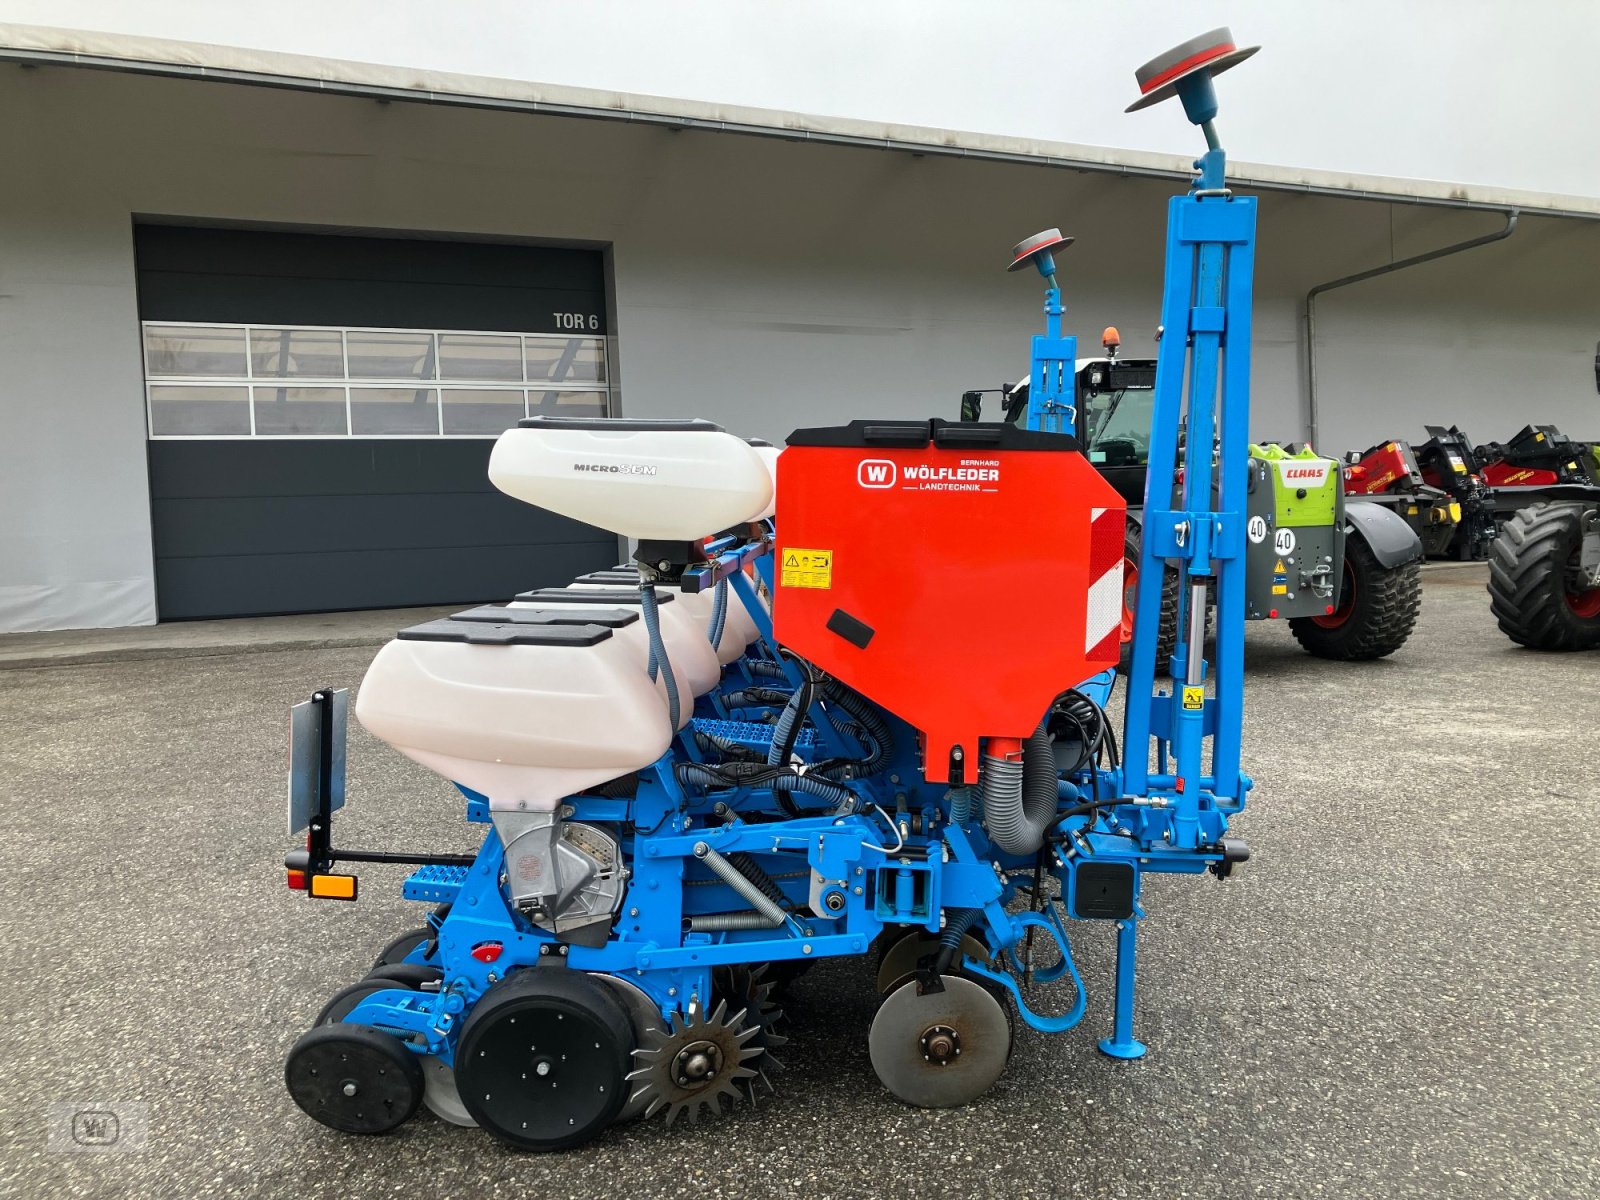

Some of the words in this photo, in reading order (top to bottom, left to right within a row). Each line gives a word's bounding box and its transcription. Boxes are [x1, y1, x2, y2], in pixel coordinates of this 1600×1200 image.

[553, 312, 585, 329] TOR
[589, 314, 599, 330] 6
[574, 463, 657, 476] MICROSEM
[960, 459, 1000, 467] BERNHARD
[867, 466, 888, 482] W
[903, 464, 1000, 481] WÖLFLEDER
[1286, 469, 1324, 478] CLAAS
[919, 482, 981, 492] LANDTECHNIK
[1250, 520, 1263, 538] 40
[1276, 532, 1291, 550] 40
